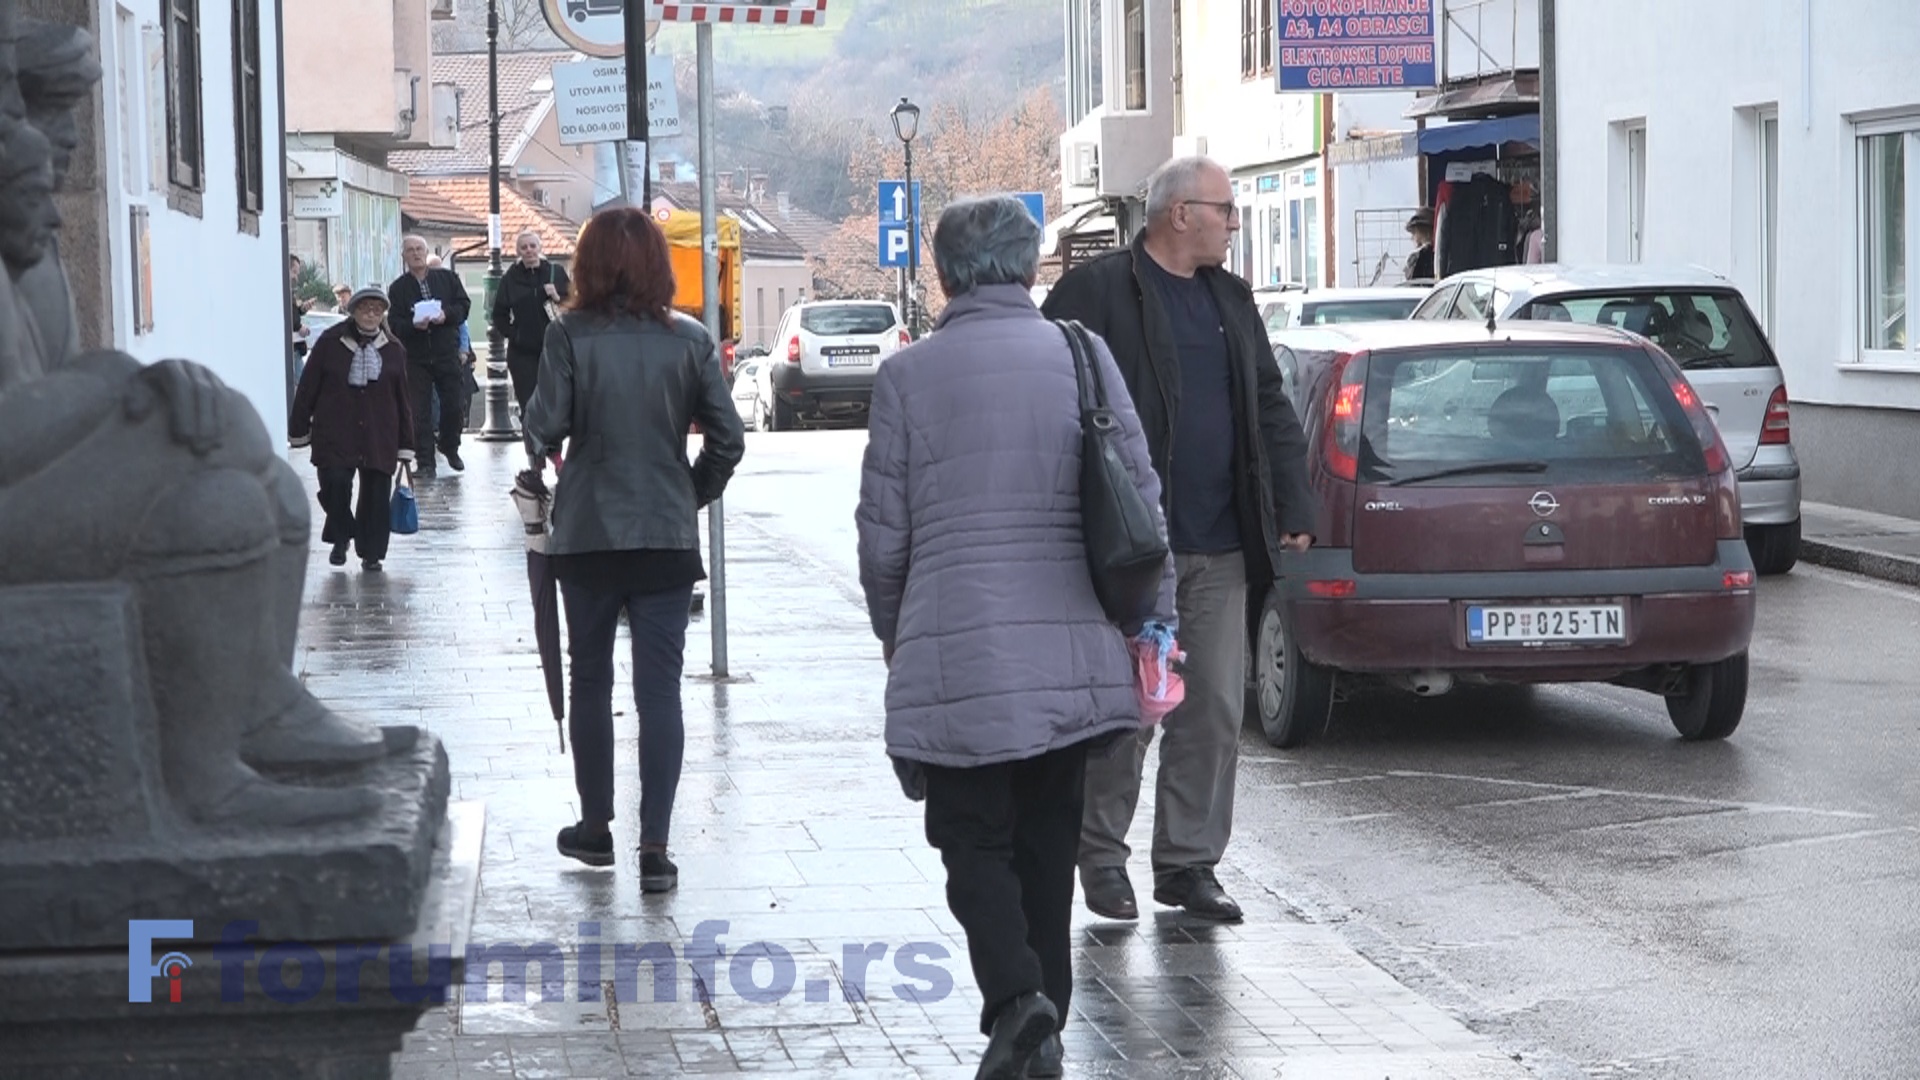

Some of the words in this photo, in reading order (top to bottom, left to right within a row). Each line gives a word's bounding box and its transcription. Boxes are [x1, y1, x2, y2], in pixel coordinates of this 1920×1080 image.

[1281, 0, 1430, 16] FOTOKOPIRANJE
[1285, 19, 1315, 39] A3,
[1318, 18, 1342, 37] A4
[1346, 16, 1428, 35] OBRASCI
[1282, 46, 1376, 67] ELEKTRONSKE
[1379, 44, 1432, 64] DOPUNE
[593, 67, 618, 77] OSIM
[1308, 66, 1404, 86] CIGARETE
[569, 84, 611, 97] UTOVAR
[561, 125, 577, 135] OD
[888, 229, 908, 261] P
[1365, 501, 1404, 511] OPEL
[1648, 496, 1690, 504] CORSA
